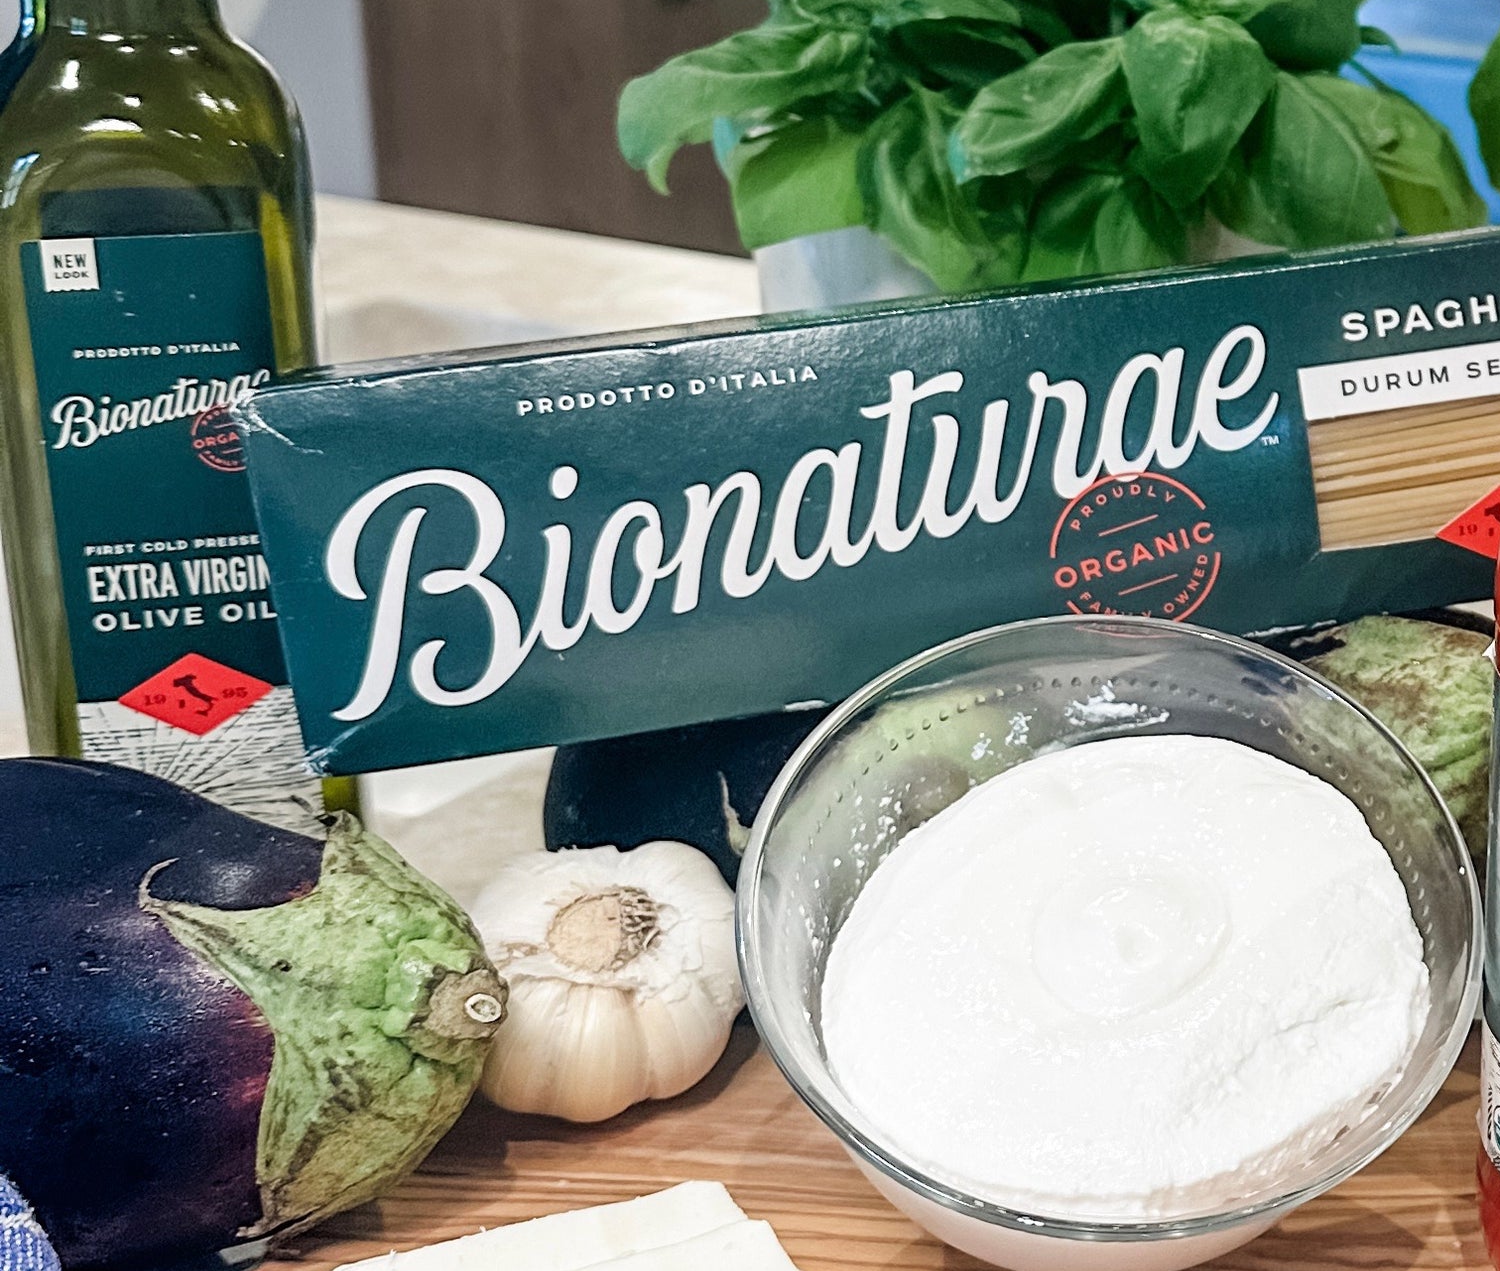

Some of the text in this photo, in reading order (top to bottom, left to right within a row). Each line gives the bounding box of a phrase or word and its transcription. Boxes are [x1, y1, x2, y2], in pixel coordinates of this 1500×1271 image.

[53, 254, 87, 269] NEW
[55, 271, 89, 279] LOOK
[72, 342, 241, 359] PRODOTTO D'ITALIA
[517, 366, 818, 416] PRODOTTO D'ITALIA
[1341, 366, 1450, 397] DURUM
[325, 324, 1279, 722] Bionaturae
[1070, 484, 1176, 531] PROUDLY
[83, 543, 135, 557] FIRST
[141, 539, 188, 553] COLD
[1054, 521, 1215, 588] ORGANIC
[87, 561, 179, 604] EXTRA
[92, 600, 278, 632] OLIVE OIL
